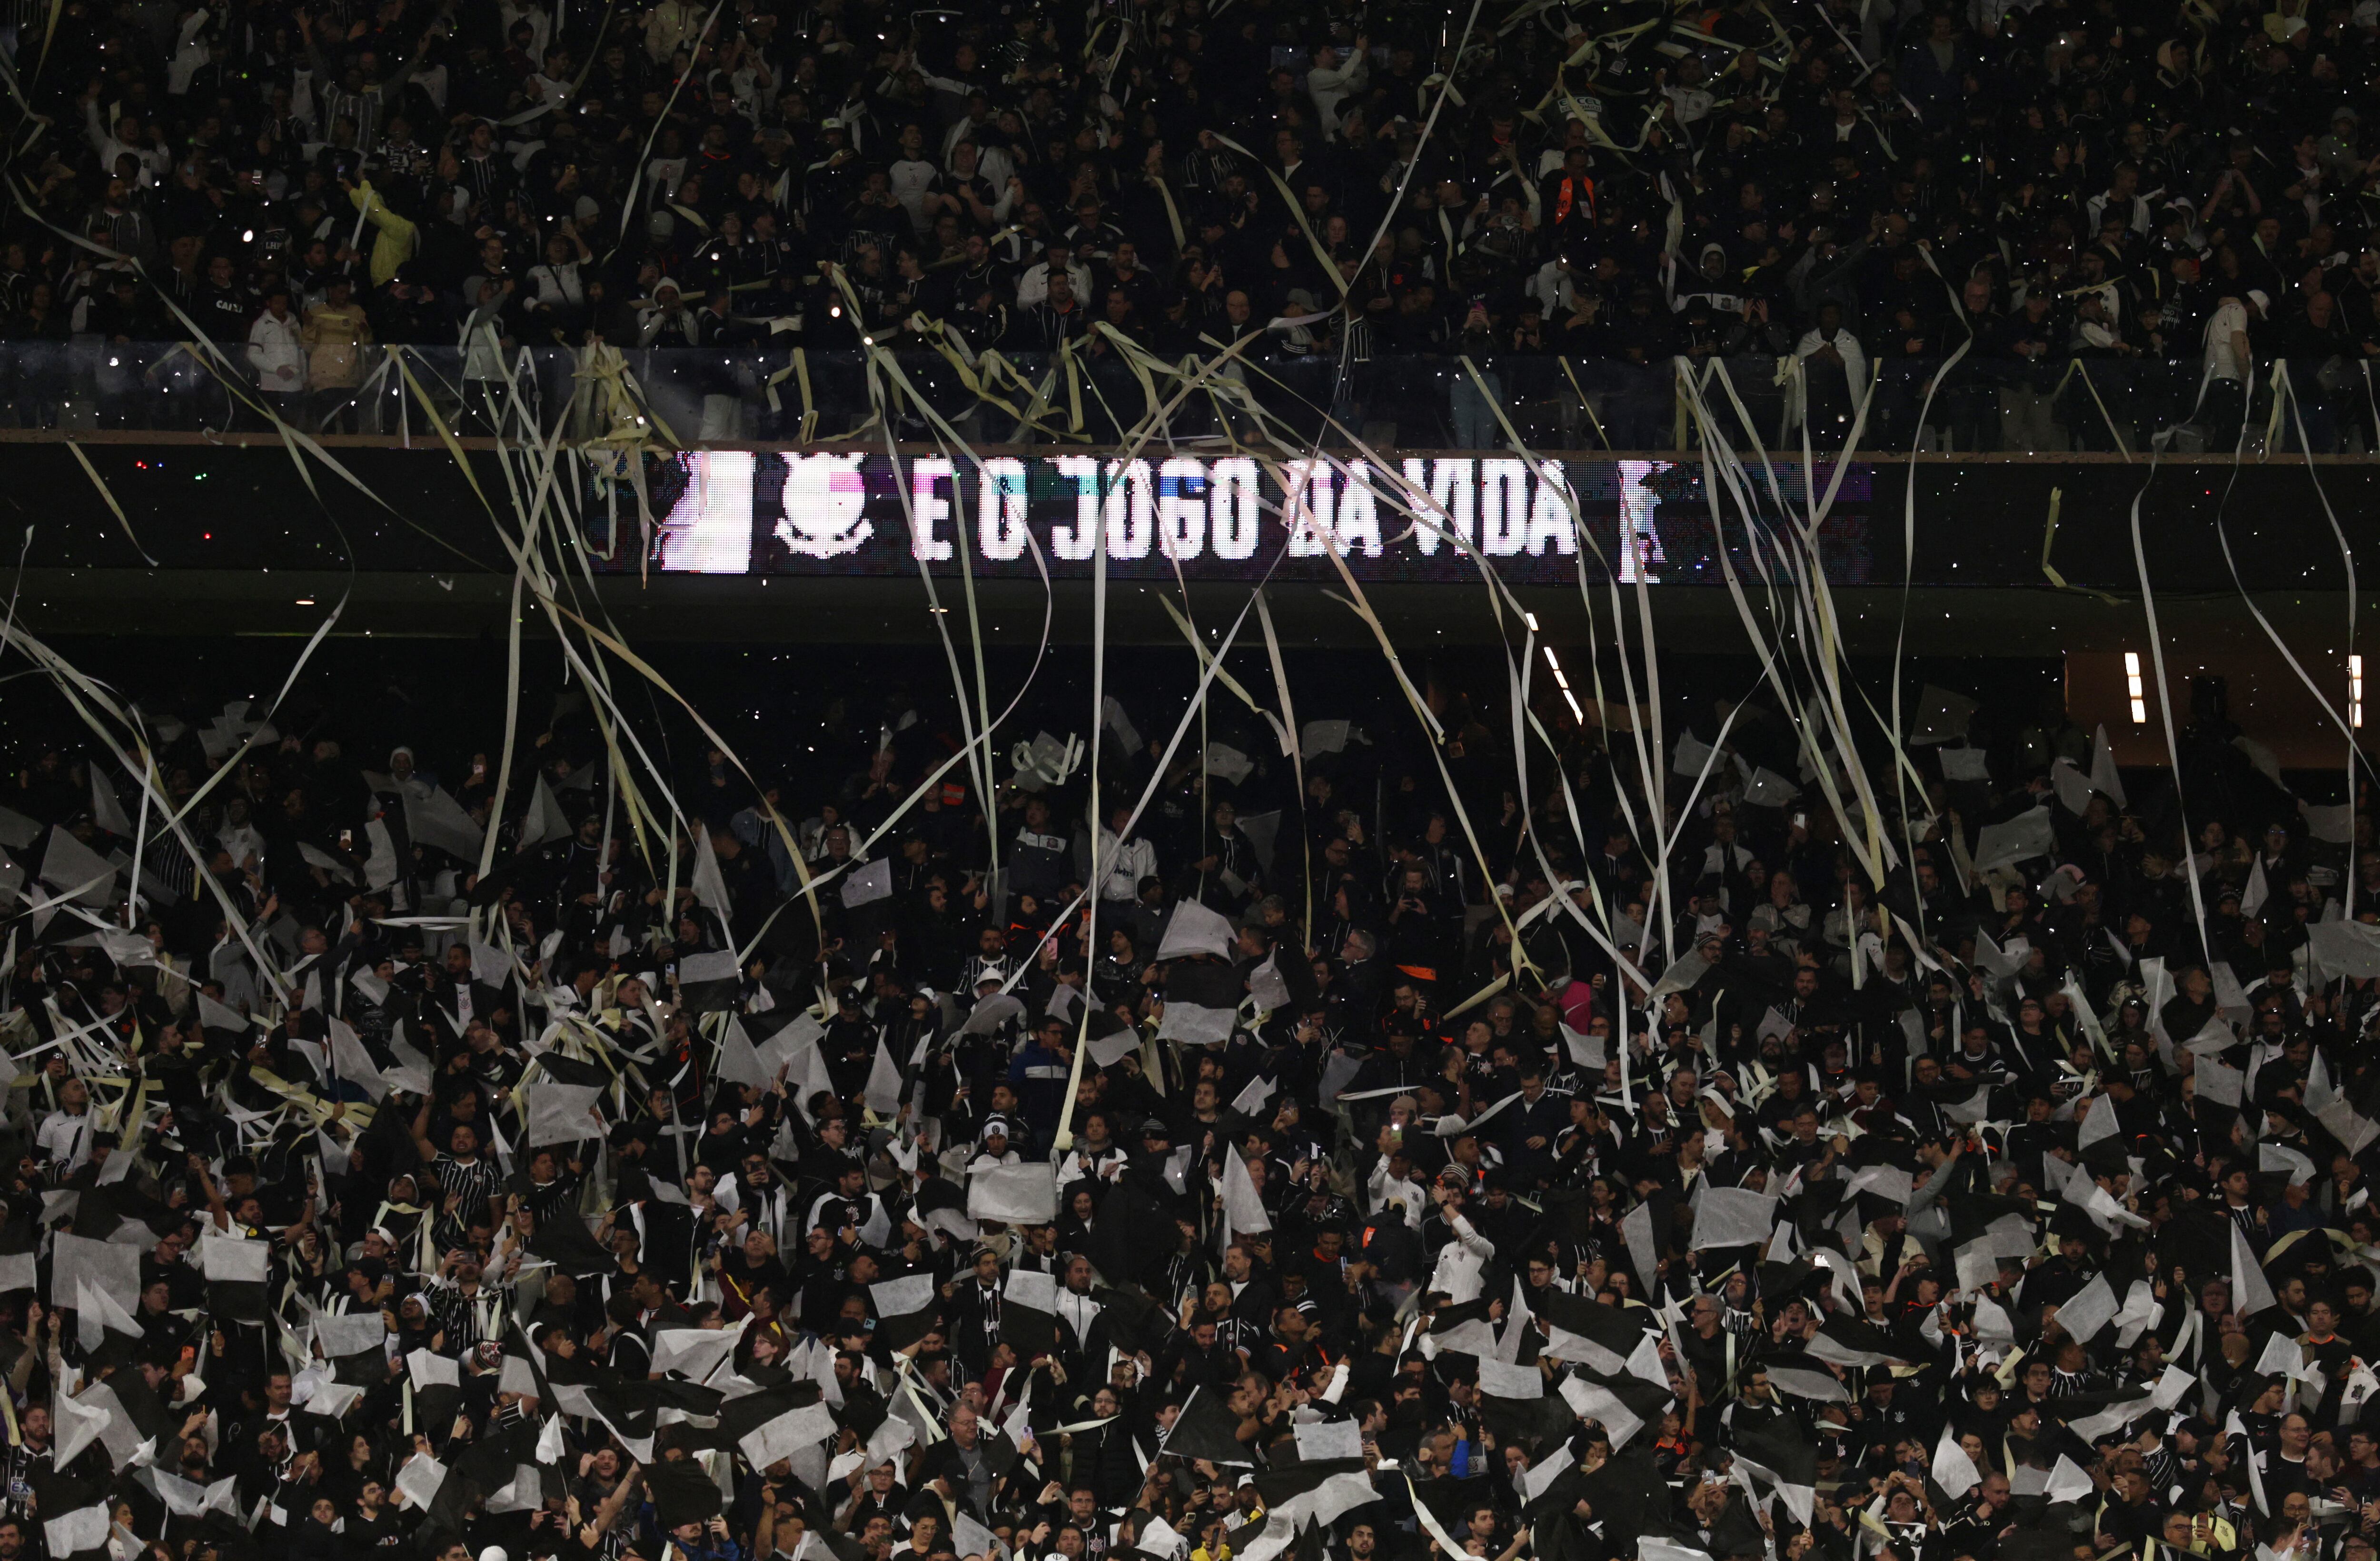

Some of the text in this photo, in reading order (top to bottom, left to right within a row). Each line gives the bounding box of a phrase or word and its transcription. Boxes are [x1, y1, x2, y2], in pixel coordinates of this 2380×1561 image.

[1558, 97, 1600, 106] ECEL
[1561, 103, 1600, 111] ECMICO
[979, 456, 1027, 561] O
[1046, 455, 1260, 561] JOGO
[1288, 458, 1382, 558] DA
[1403, 458, 1577, 557] VIDA
